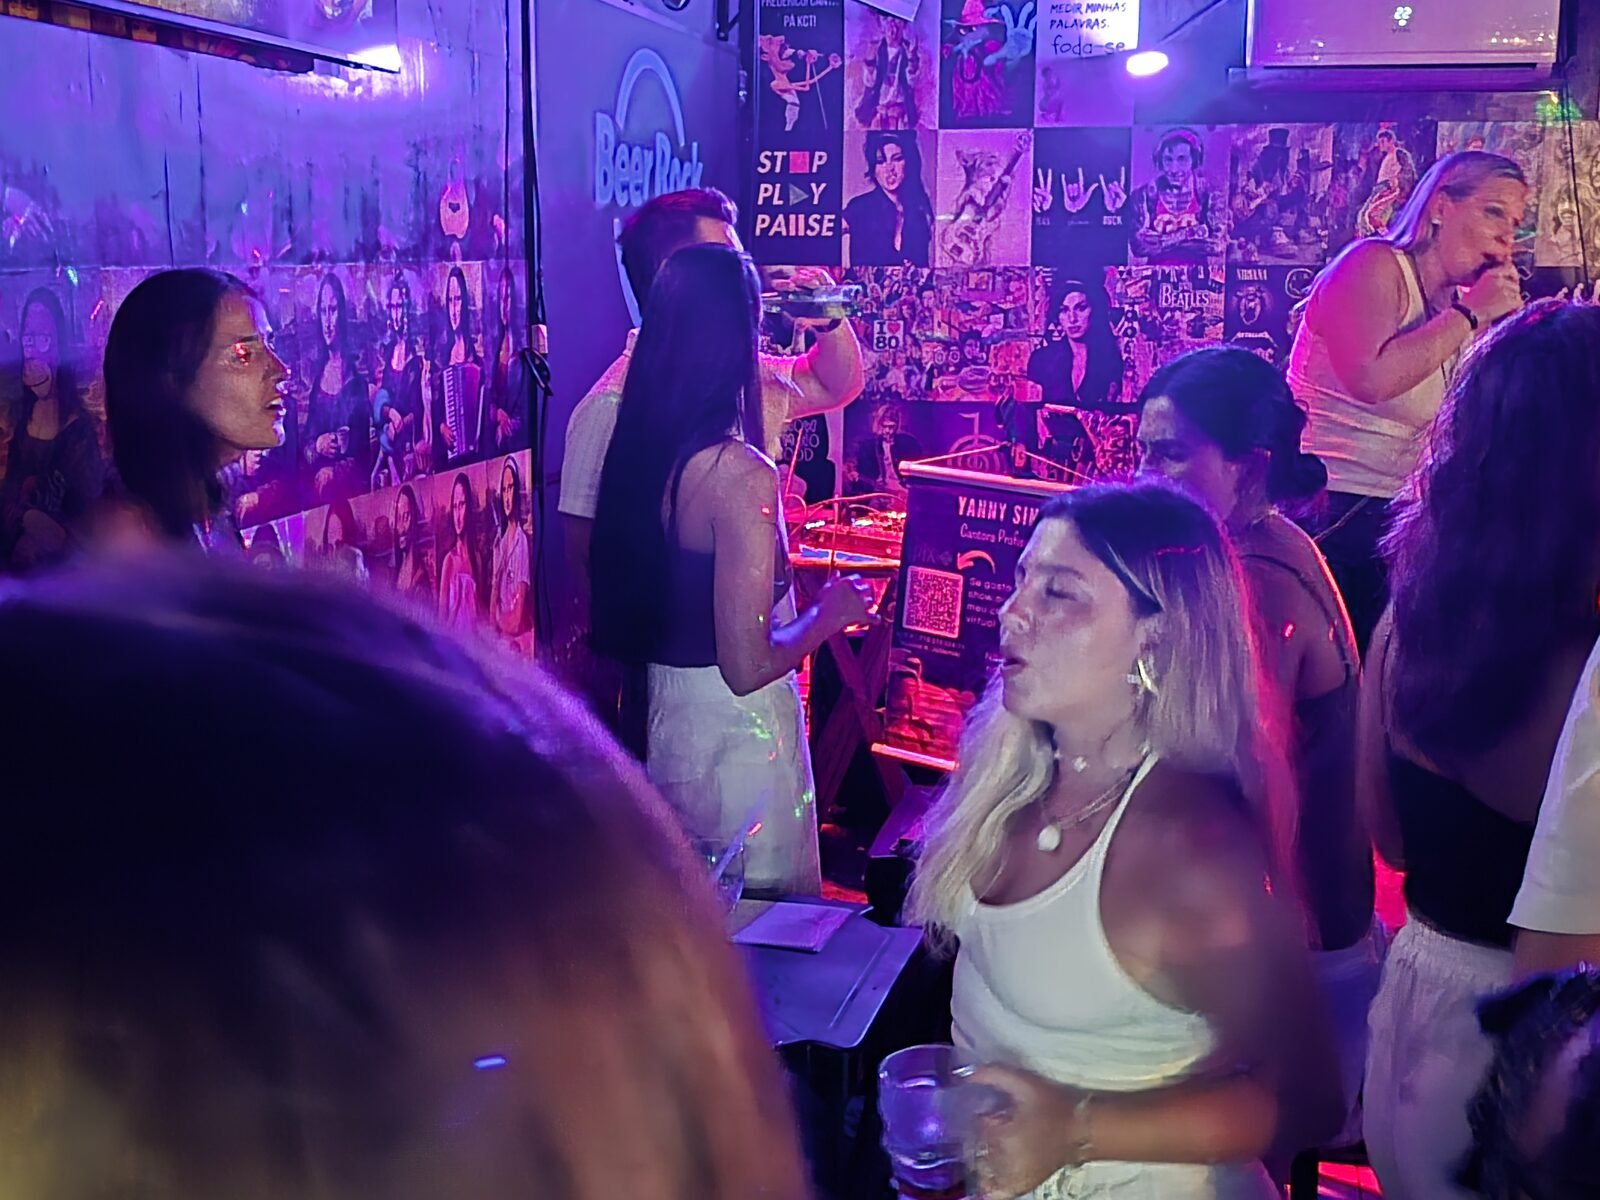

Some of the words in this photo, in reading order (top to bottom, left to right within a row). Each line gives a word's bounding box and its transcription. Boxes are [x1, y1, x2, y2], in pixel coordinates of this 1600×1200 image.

[1085, 3, 1126, 13] MINHAS
[1051, 35, 1125, 56] foda-se
[875, 336, 899, 349] 80
[958, 496, 1007, 522] YANNY
